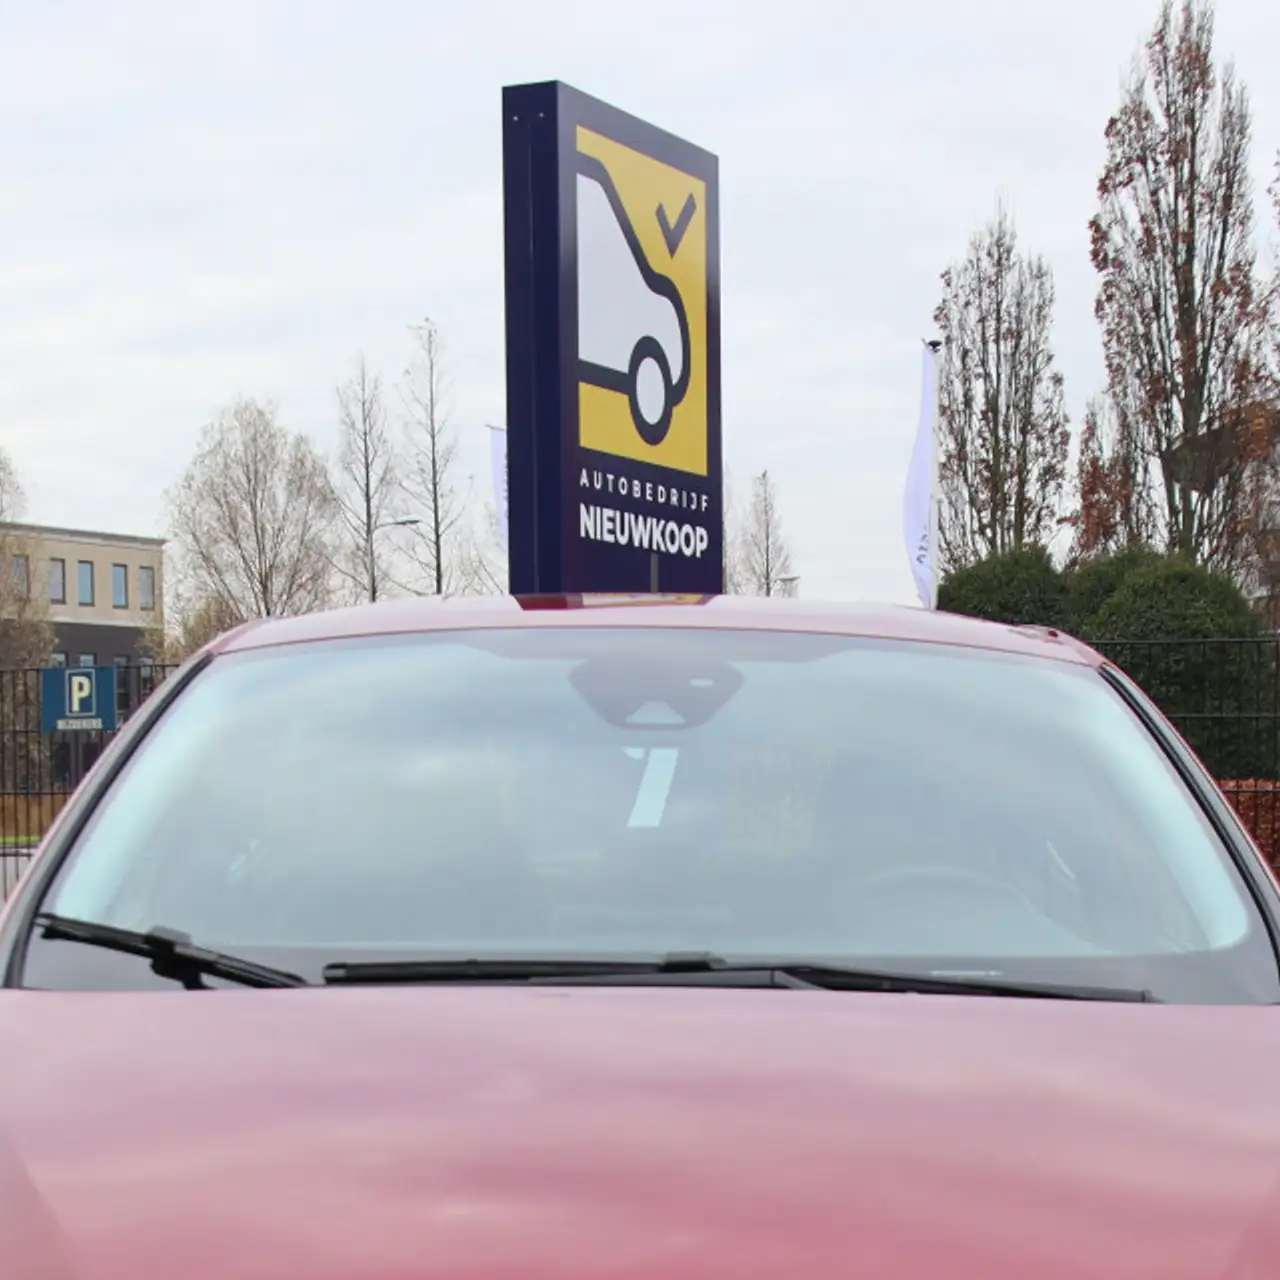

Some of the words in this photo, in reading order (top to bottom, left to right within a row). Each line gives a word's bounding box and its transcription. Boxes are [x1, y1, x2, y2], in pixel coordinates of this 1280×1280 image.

[579, 468, 709, 512] AUTOBEDRIJF
[579, 502, 709, 558] NIEUWKOOP
[71, 675, 91, 712] P
